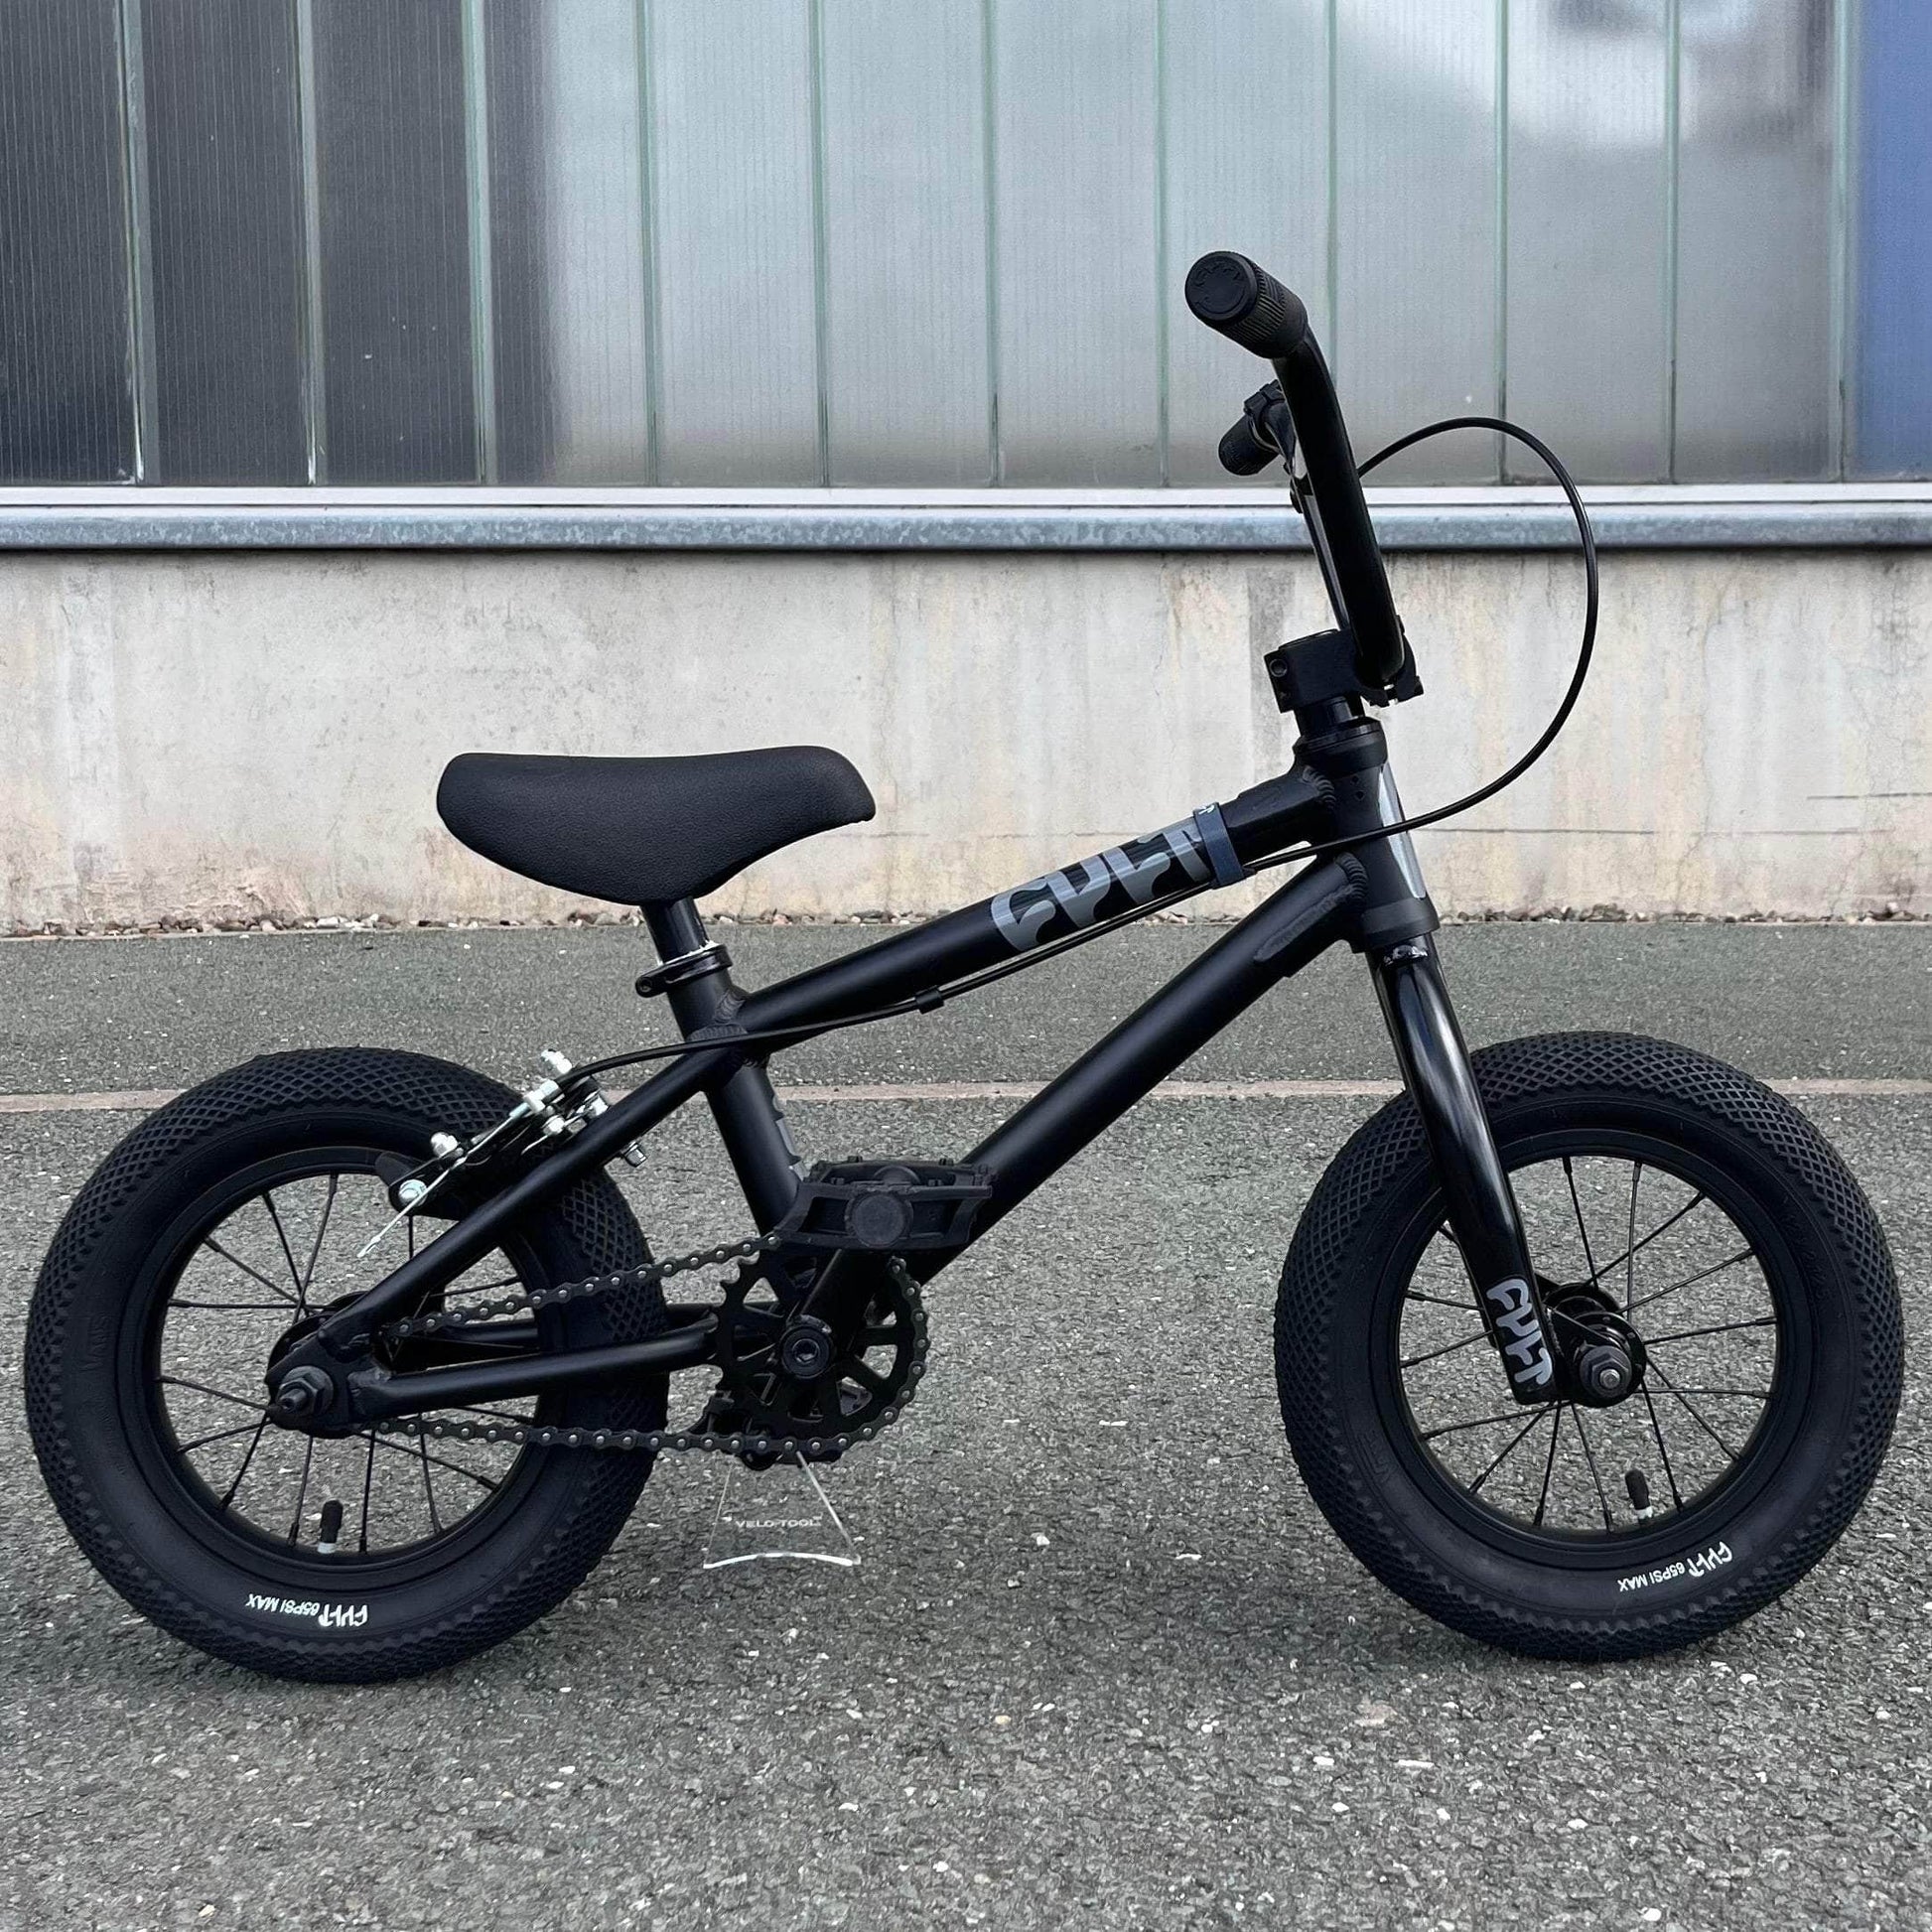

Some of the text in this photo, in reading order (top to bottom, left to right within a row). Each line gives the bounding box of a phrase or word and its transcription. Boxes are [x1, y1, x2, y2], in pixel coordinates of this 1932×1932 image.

[991, 816, 1211, 951] CULT
[1486, 1279, 1553, 1385] CULT
[1617, 1541, 1733, 1592] CULT 65PSI MAX
[245, 1593, 368, 1627] CULT 65PSI MAX
